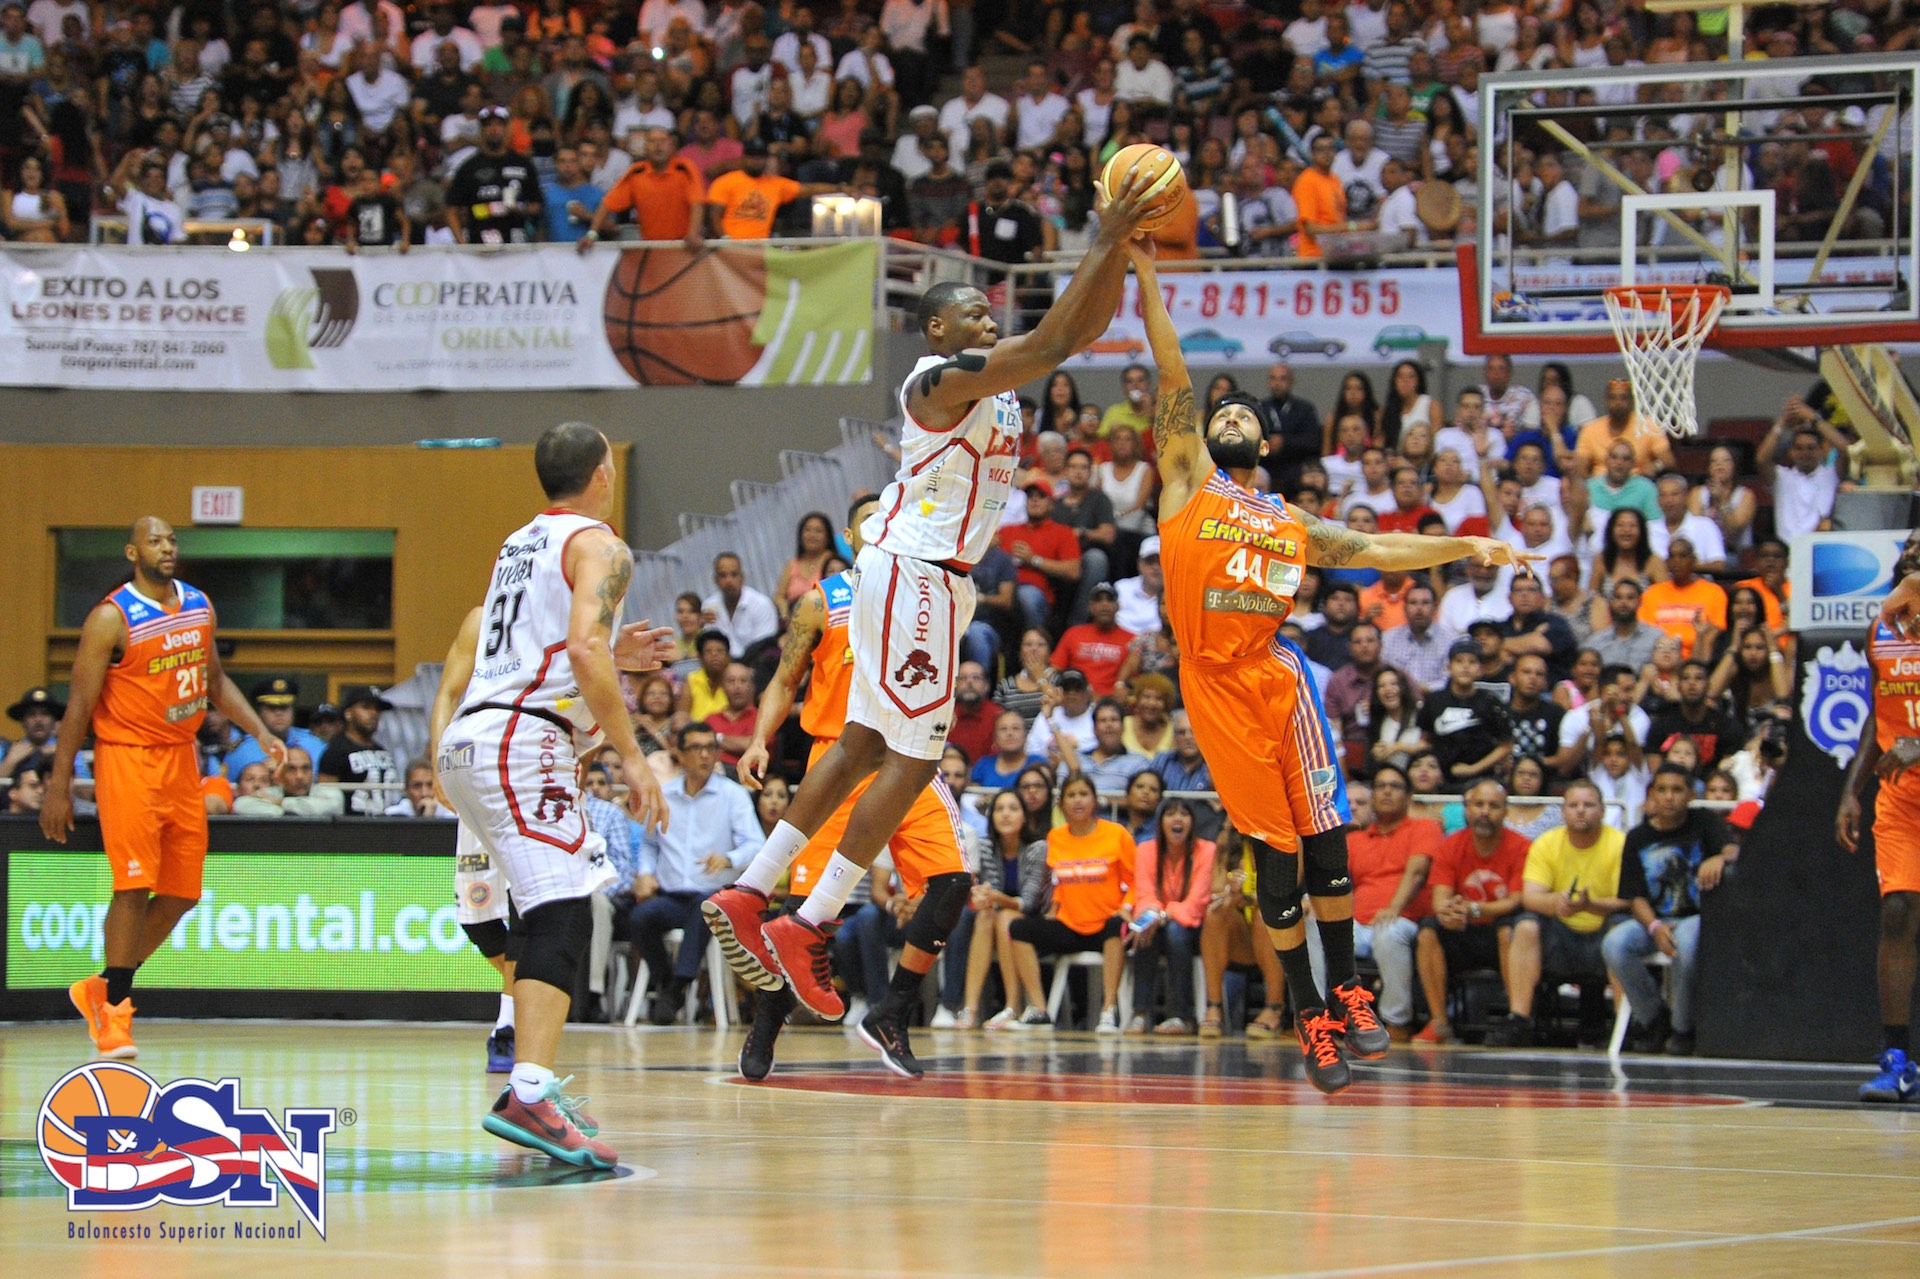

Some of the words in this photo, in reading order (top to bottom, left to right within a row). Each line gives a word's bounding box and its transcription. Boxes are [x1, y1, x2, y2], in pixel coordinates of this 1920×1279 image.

[41, 276, 127, 299] EXITO
[135, 279, 157, 299] A
[164, 278, 220, 300] LOS
[372, 281, 579, 309] COOPERATIVA
[11, 302, 111, 321] LEONES
[118, 304, 151, 322] DE
[160, 305, 246, 324] PONCE
[441, 326, 576, 350] ORIENTAL
[200, 491, 235, 516] EXIT
[1227, 500, 1276, 532] Jeep
[1225, 548, 1263, 587] 44
[914, 575, 931, 642] RICOH
[483, 587, 526, 660] 31
[162, 629, 201, 651] Jeep
[176, 666, 198, 700] 21
[1825, 674, 1866, 691] DON
[1819, 690, 1870, 742] Q
